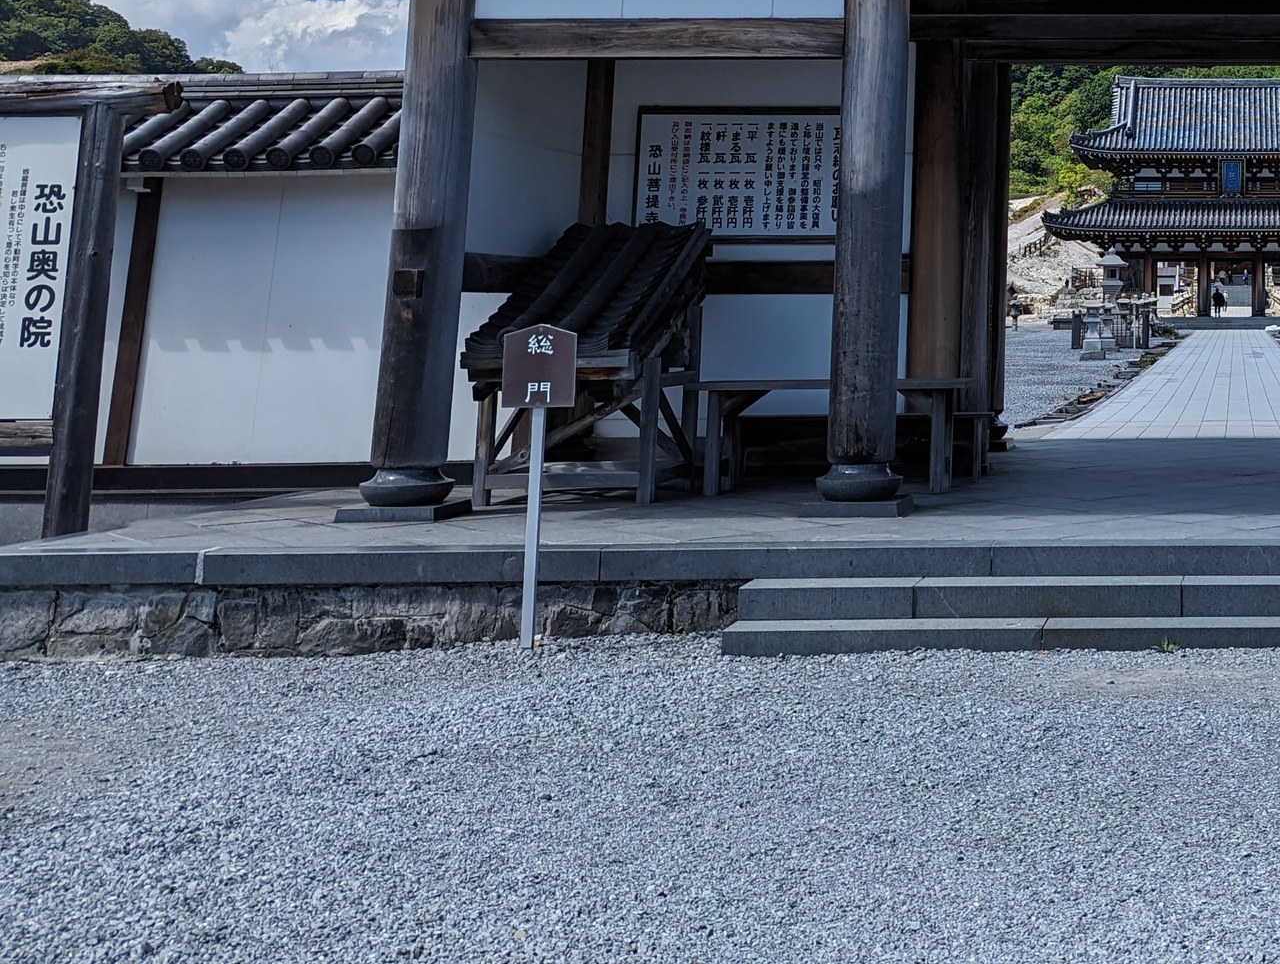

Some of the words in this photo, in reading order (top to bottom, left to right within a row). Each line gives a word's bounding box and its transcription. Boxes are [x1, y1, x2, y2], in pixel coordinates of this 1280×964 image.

[644, 144, 664, 225] 恐山菩提寺
[19, 183, 67, 349] 恐山奥の院
[524, 334, 554, 404] 総門
